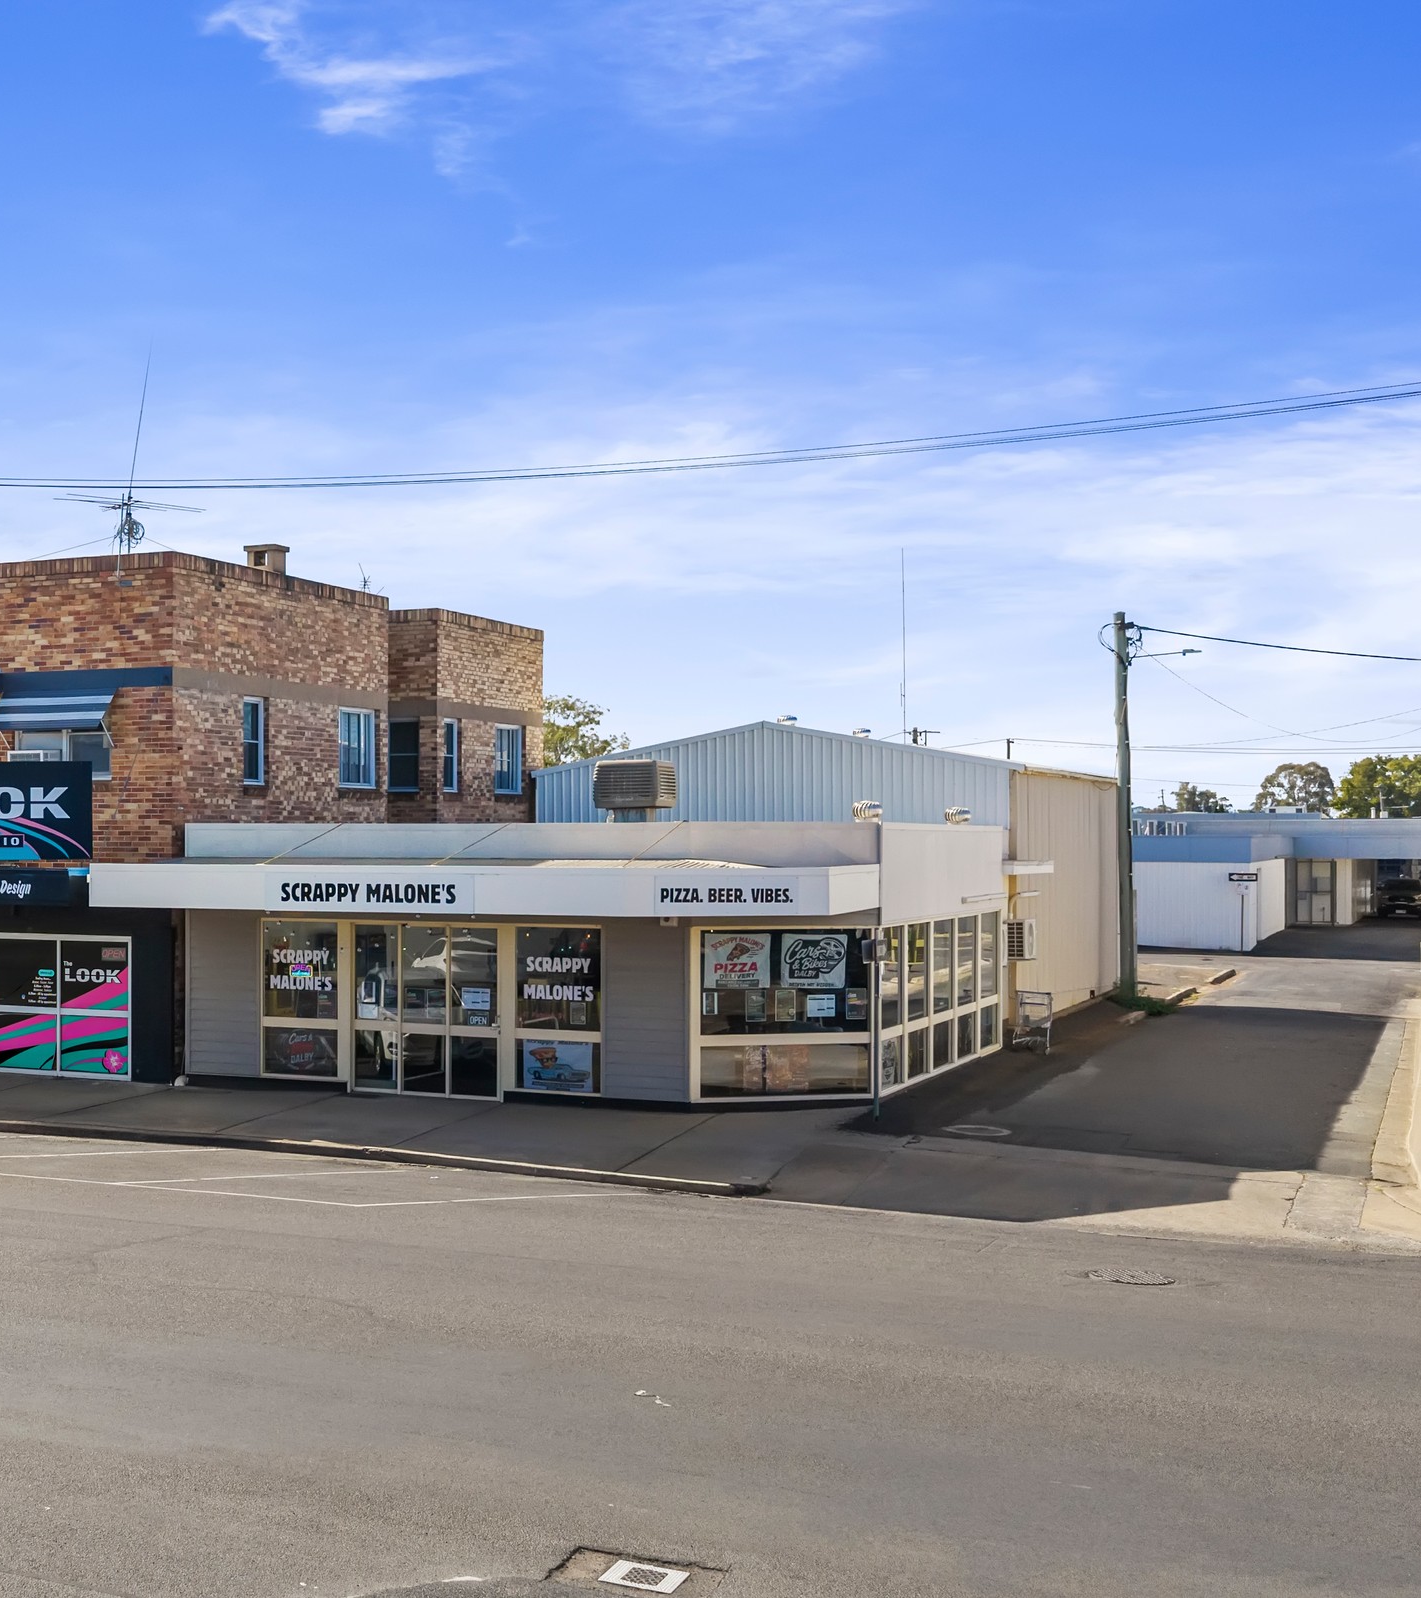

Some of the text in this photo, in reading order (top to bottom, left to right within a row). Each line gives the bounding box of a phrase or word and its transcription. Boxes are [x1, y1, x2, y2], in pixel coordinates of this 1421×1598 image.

[0, 880, 31, 899] Design
[281, 882, 456, 904] SCRAPPY MALONE'S
[660, 888, 793, 903] PIZZA. BEER. VIBES.
[102, 950, 125, 958] OPEN
[272, 949, 330, 964] SCRAPPY
[786, 940, 824, 963] Cars
[526, 956, 591, 973] SCRAPPY
[714, 962, 758, 973] PIZZA
[792, 958, 827, 970] & Bikes
[64, 968, 122, 983] LOOK
[270, 975, 332, 991] MALONE'S
[524, 984, 594, 1002] MALONE'S
[470, 1016, 487, 1024] OPEN
[289, 1033, 307, 1044] Cars
